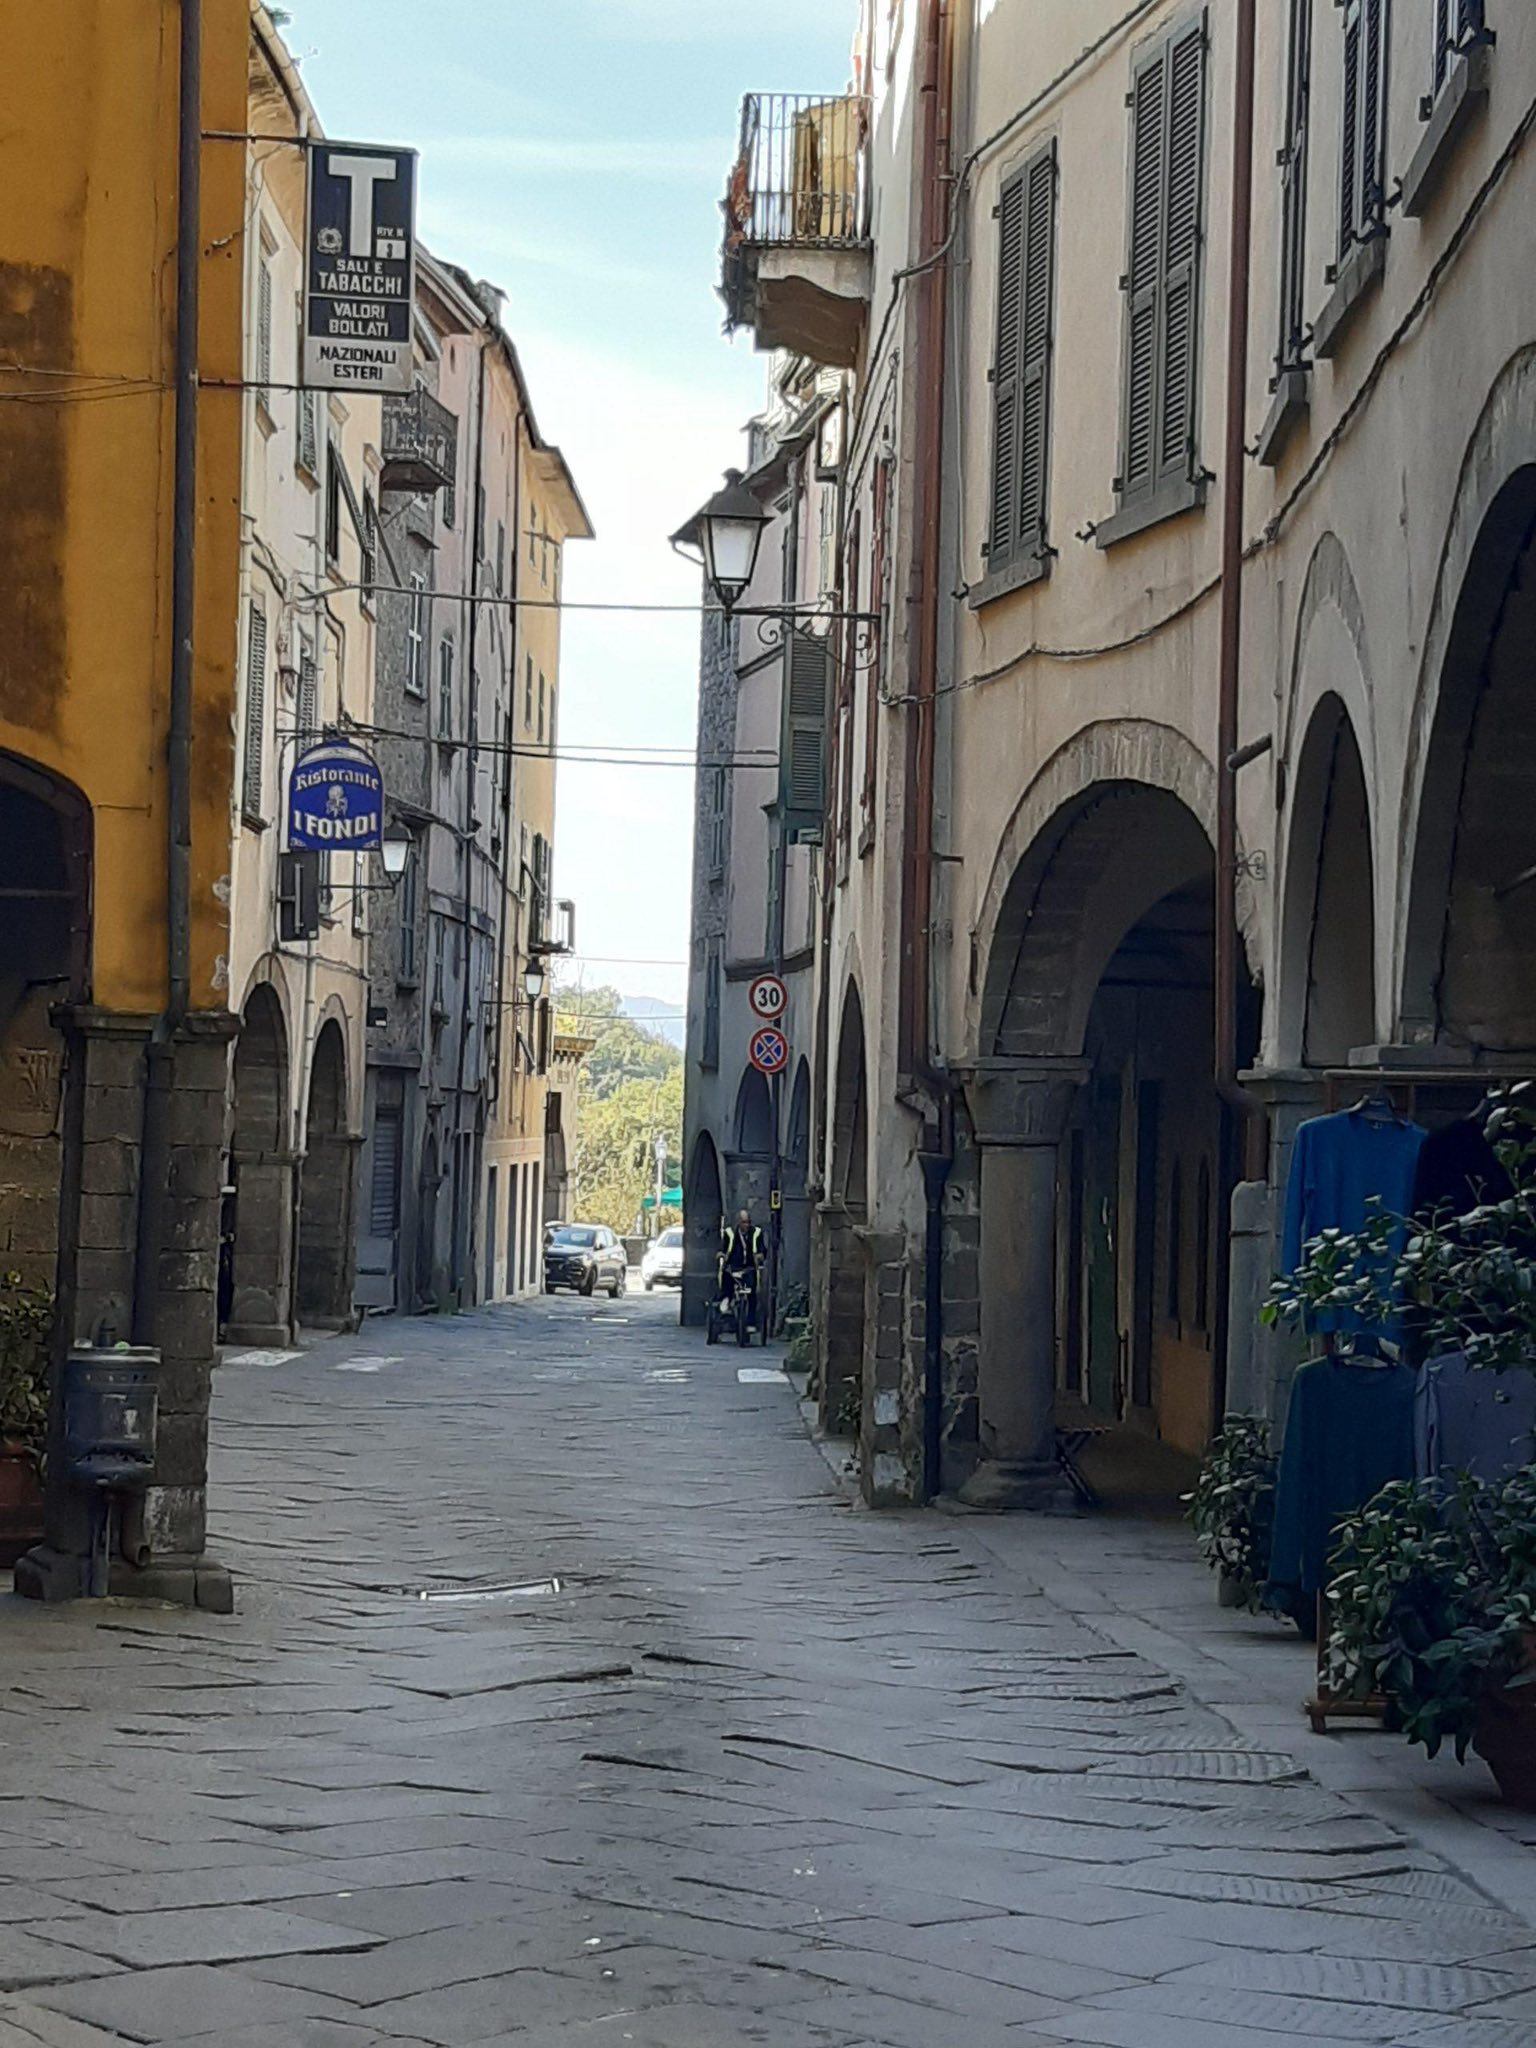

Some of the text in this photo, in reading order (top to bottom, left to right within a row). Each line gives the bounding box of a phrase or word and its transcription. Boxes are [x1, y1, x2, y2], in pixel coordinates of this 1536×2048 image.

[329, 155, 396, 257] T
[336, 259, 383, 275] SALI E
[319, 271, 402, 295] TABACCHI
[333, 301, 386, 320] VALORI
[329, 319, 389, 337] BOLLATI
[320, 346, 396, 364] NAZIONALI
[333, 363, 383, 381] ESTERI
[295, 768, 379, 791] Ristorante
[294, 810, 377, 839] I FONDI
[758, 987, 780, 1007] 30
